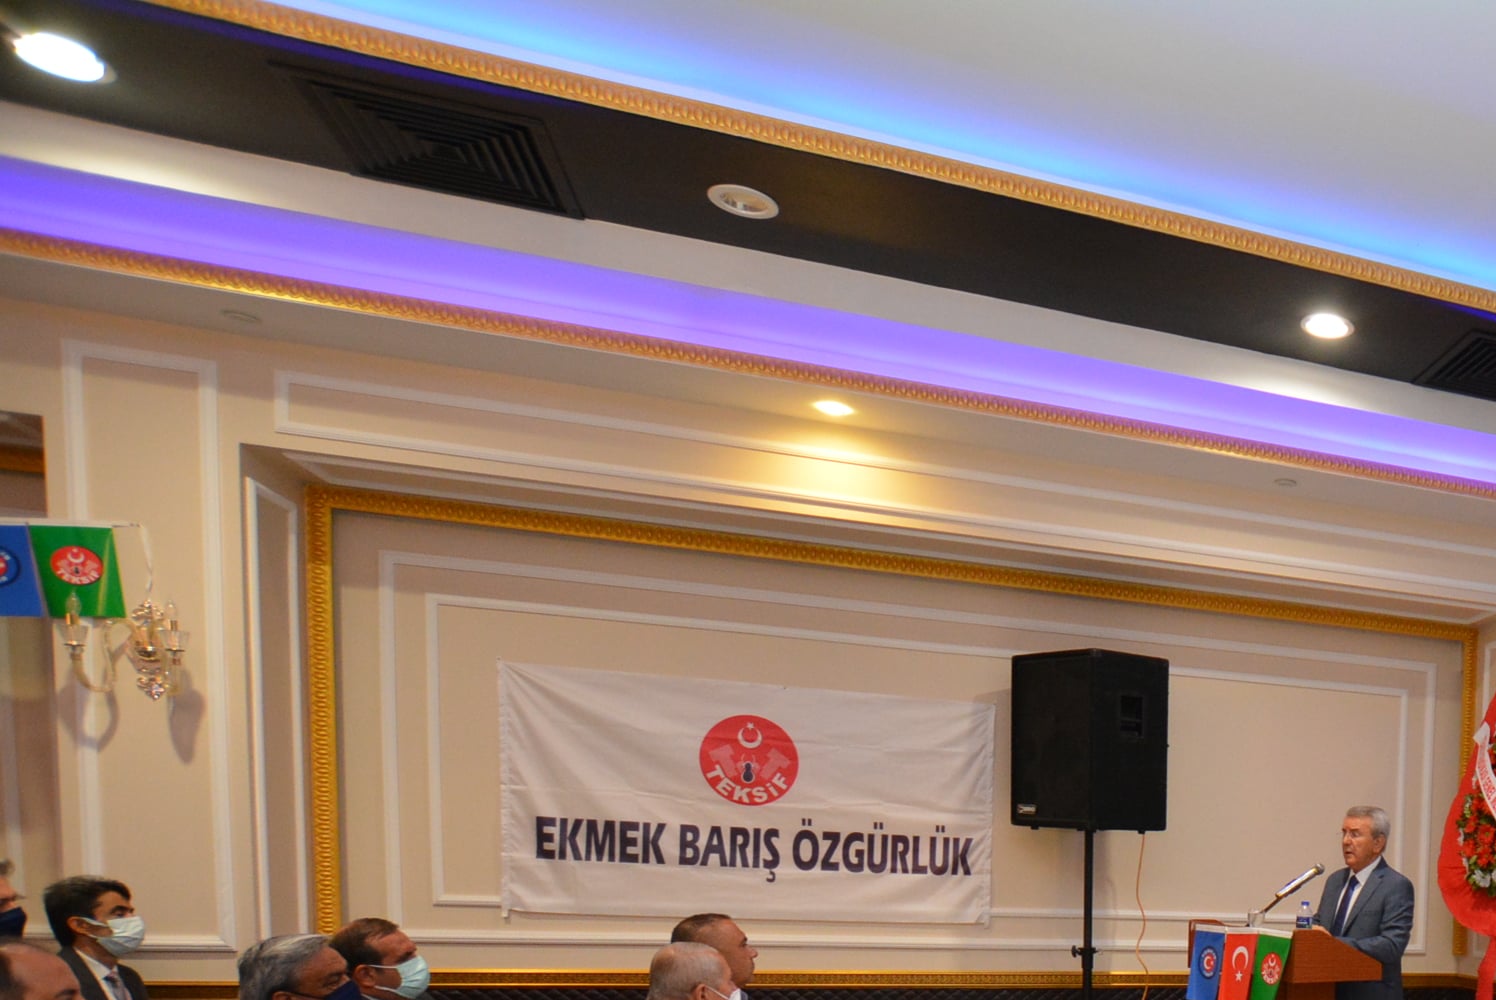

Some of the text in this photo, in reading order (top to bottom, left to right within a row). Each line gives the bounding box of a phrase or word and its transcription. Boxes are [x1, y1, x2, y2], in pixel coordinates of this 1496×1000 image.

[535, 816, 974, 883] EKMEK BARIŞ ÖZGÜRLÜK
